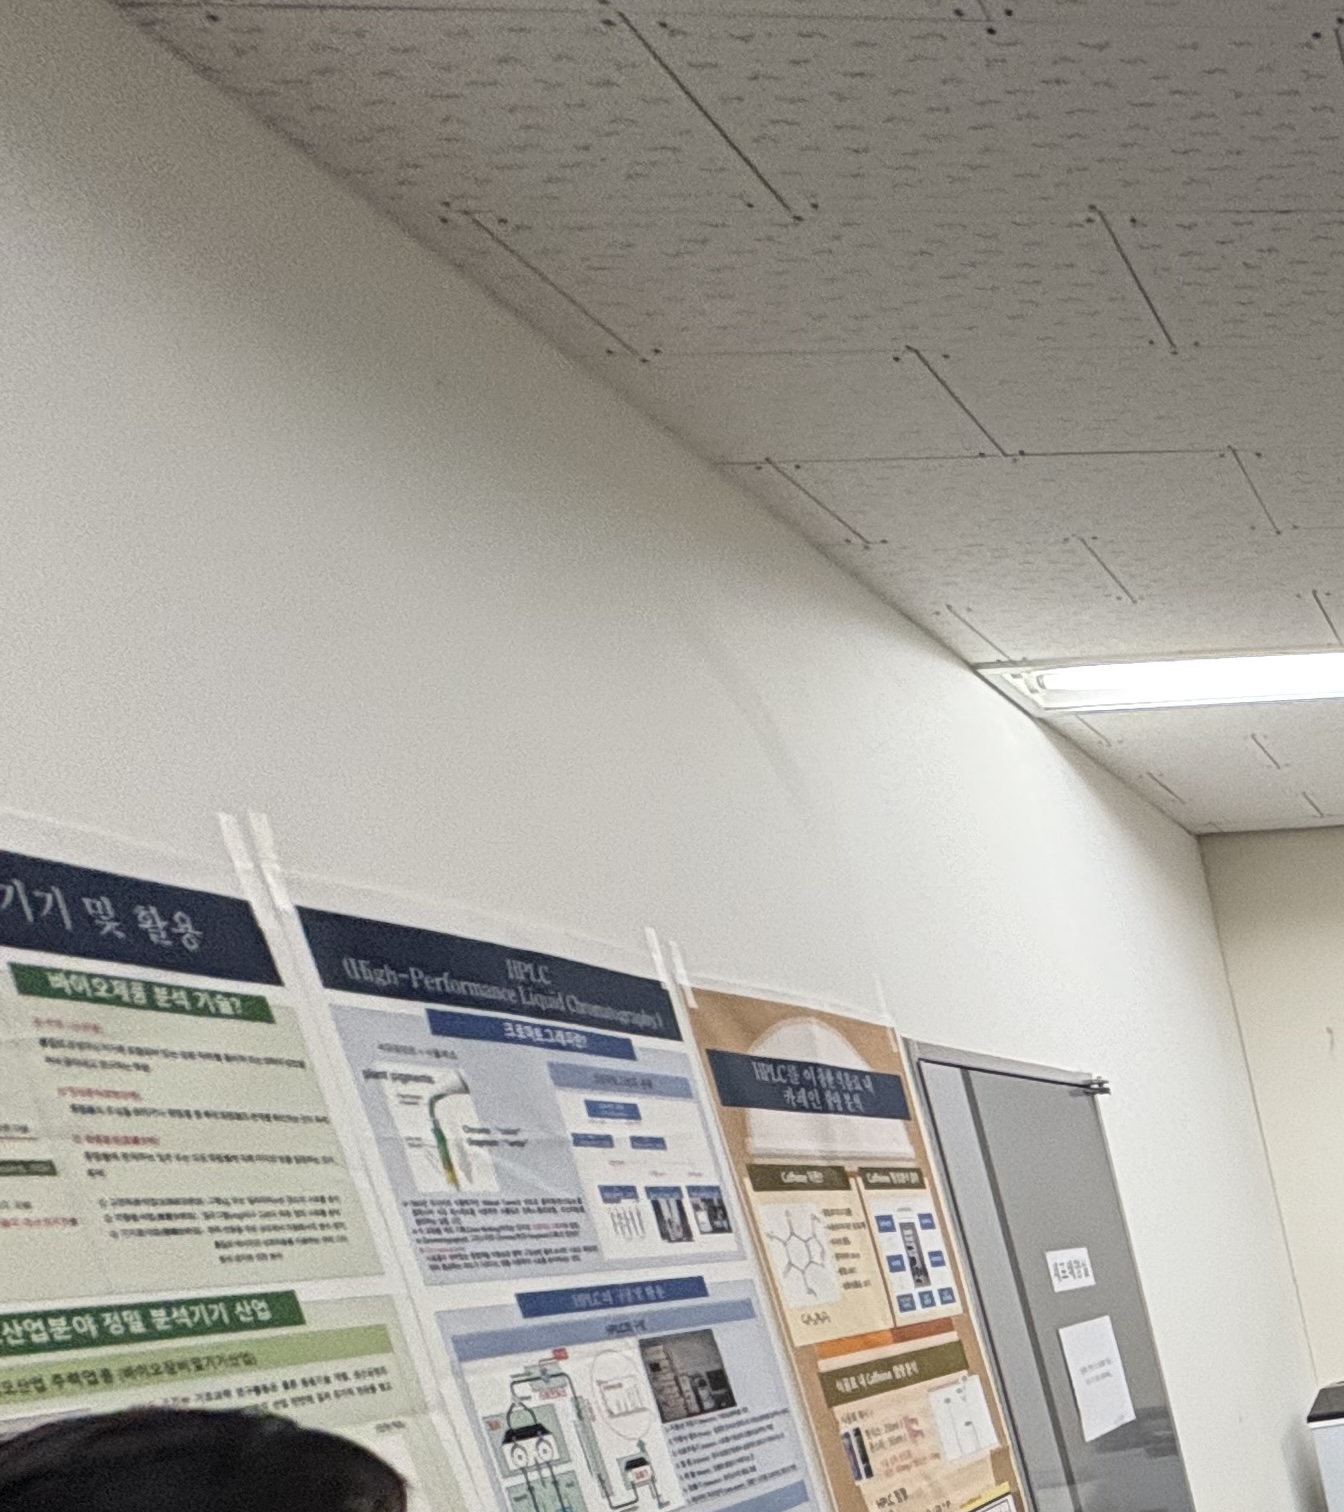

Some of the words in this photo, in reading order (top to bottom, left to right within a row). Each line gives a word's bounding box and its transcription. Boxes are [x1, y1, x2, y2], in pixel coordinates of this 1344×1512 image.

[82, 896, 126, 939] 및
[133, 905, 203, 951] 활용
[505, 958, 553, 985] HPLC
[152, 991, 192, 1011] 분석
[0, 1315, 98, 1346] 산업분야
[101, 1310, 146, 1336] 정밀
[149, 1304, 230, 1330] 분석기기
[234, 1299, 273, 1323] 산업
